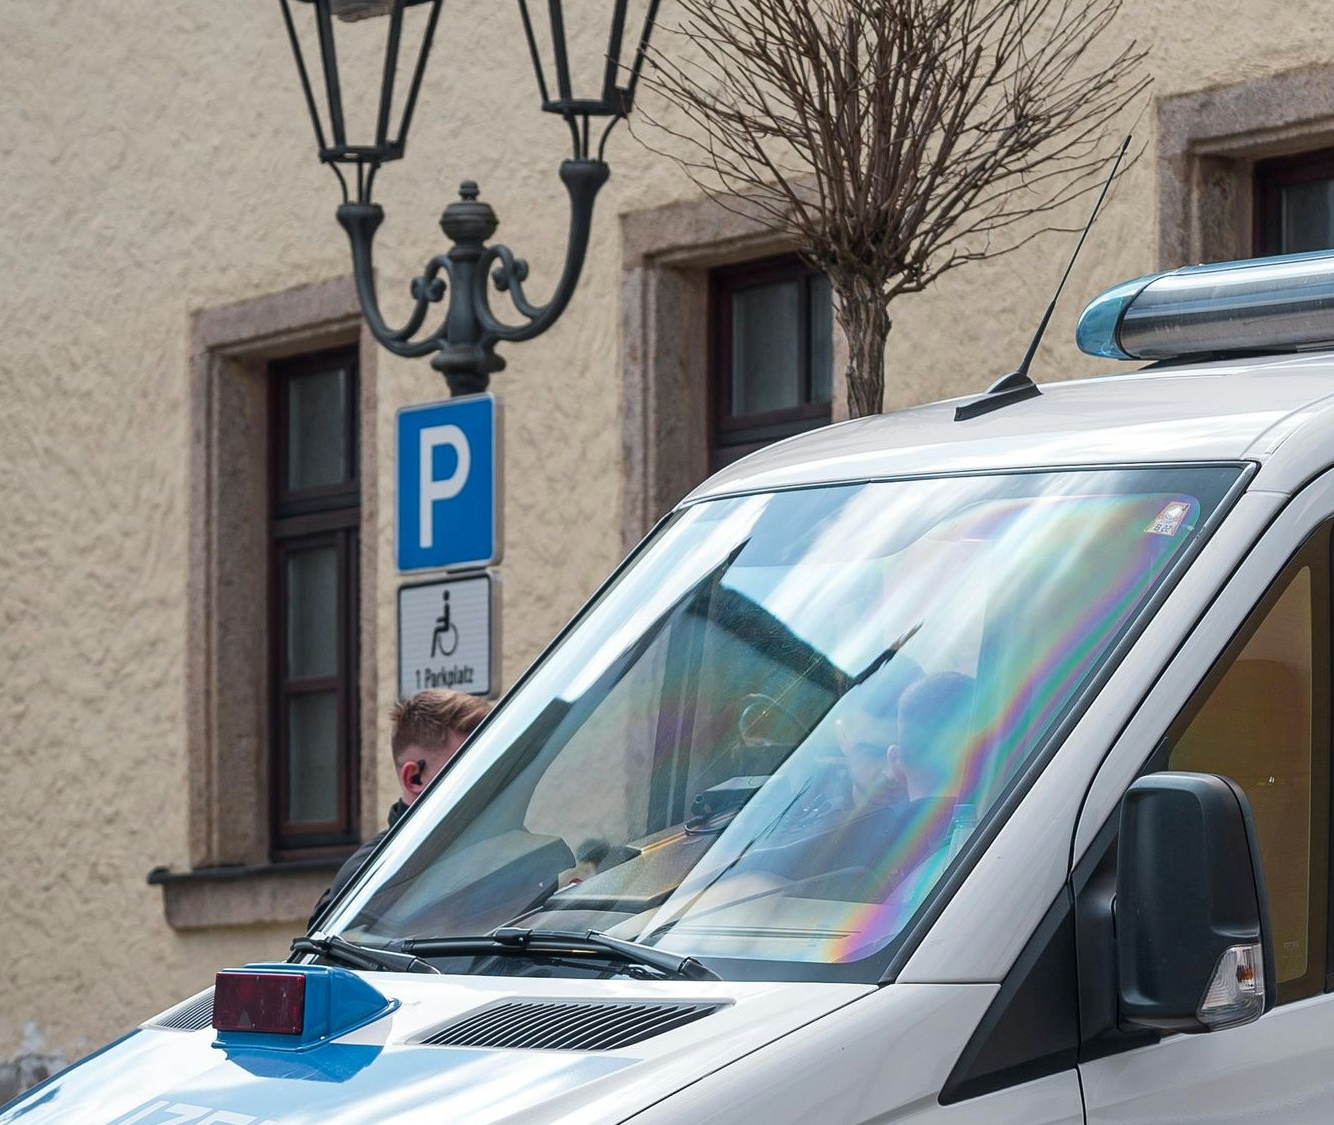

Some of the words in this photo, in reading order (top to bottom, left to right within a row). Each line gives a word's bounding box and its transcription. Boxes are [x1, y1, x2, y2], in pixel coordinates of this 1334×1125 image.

[419, 424, 472, 549] P
[415, 669, 421, 689] 1
[424, 665, 474, 689] Parkplatz
